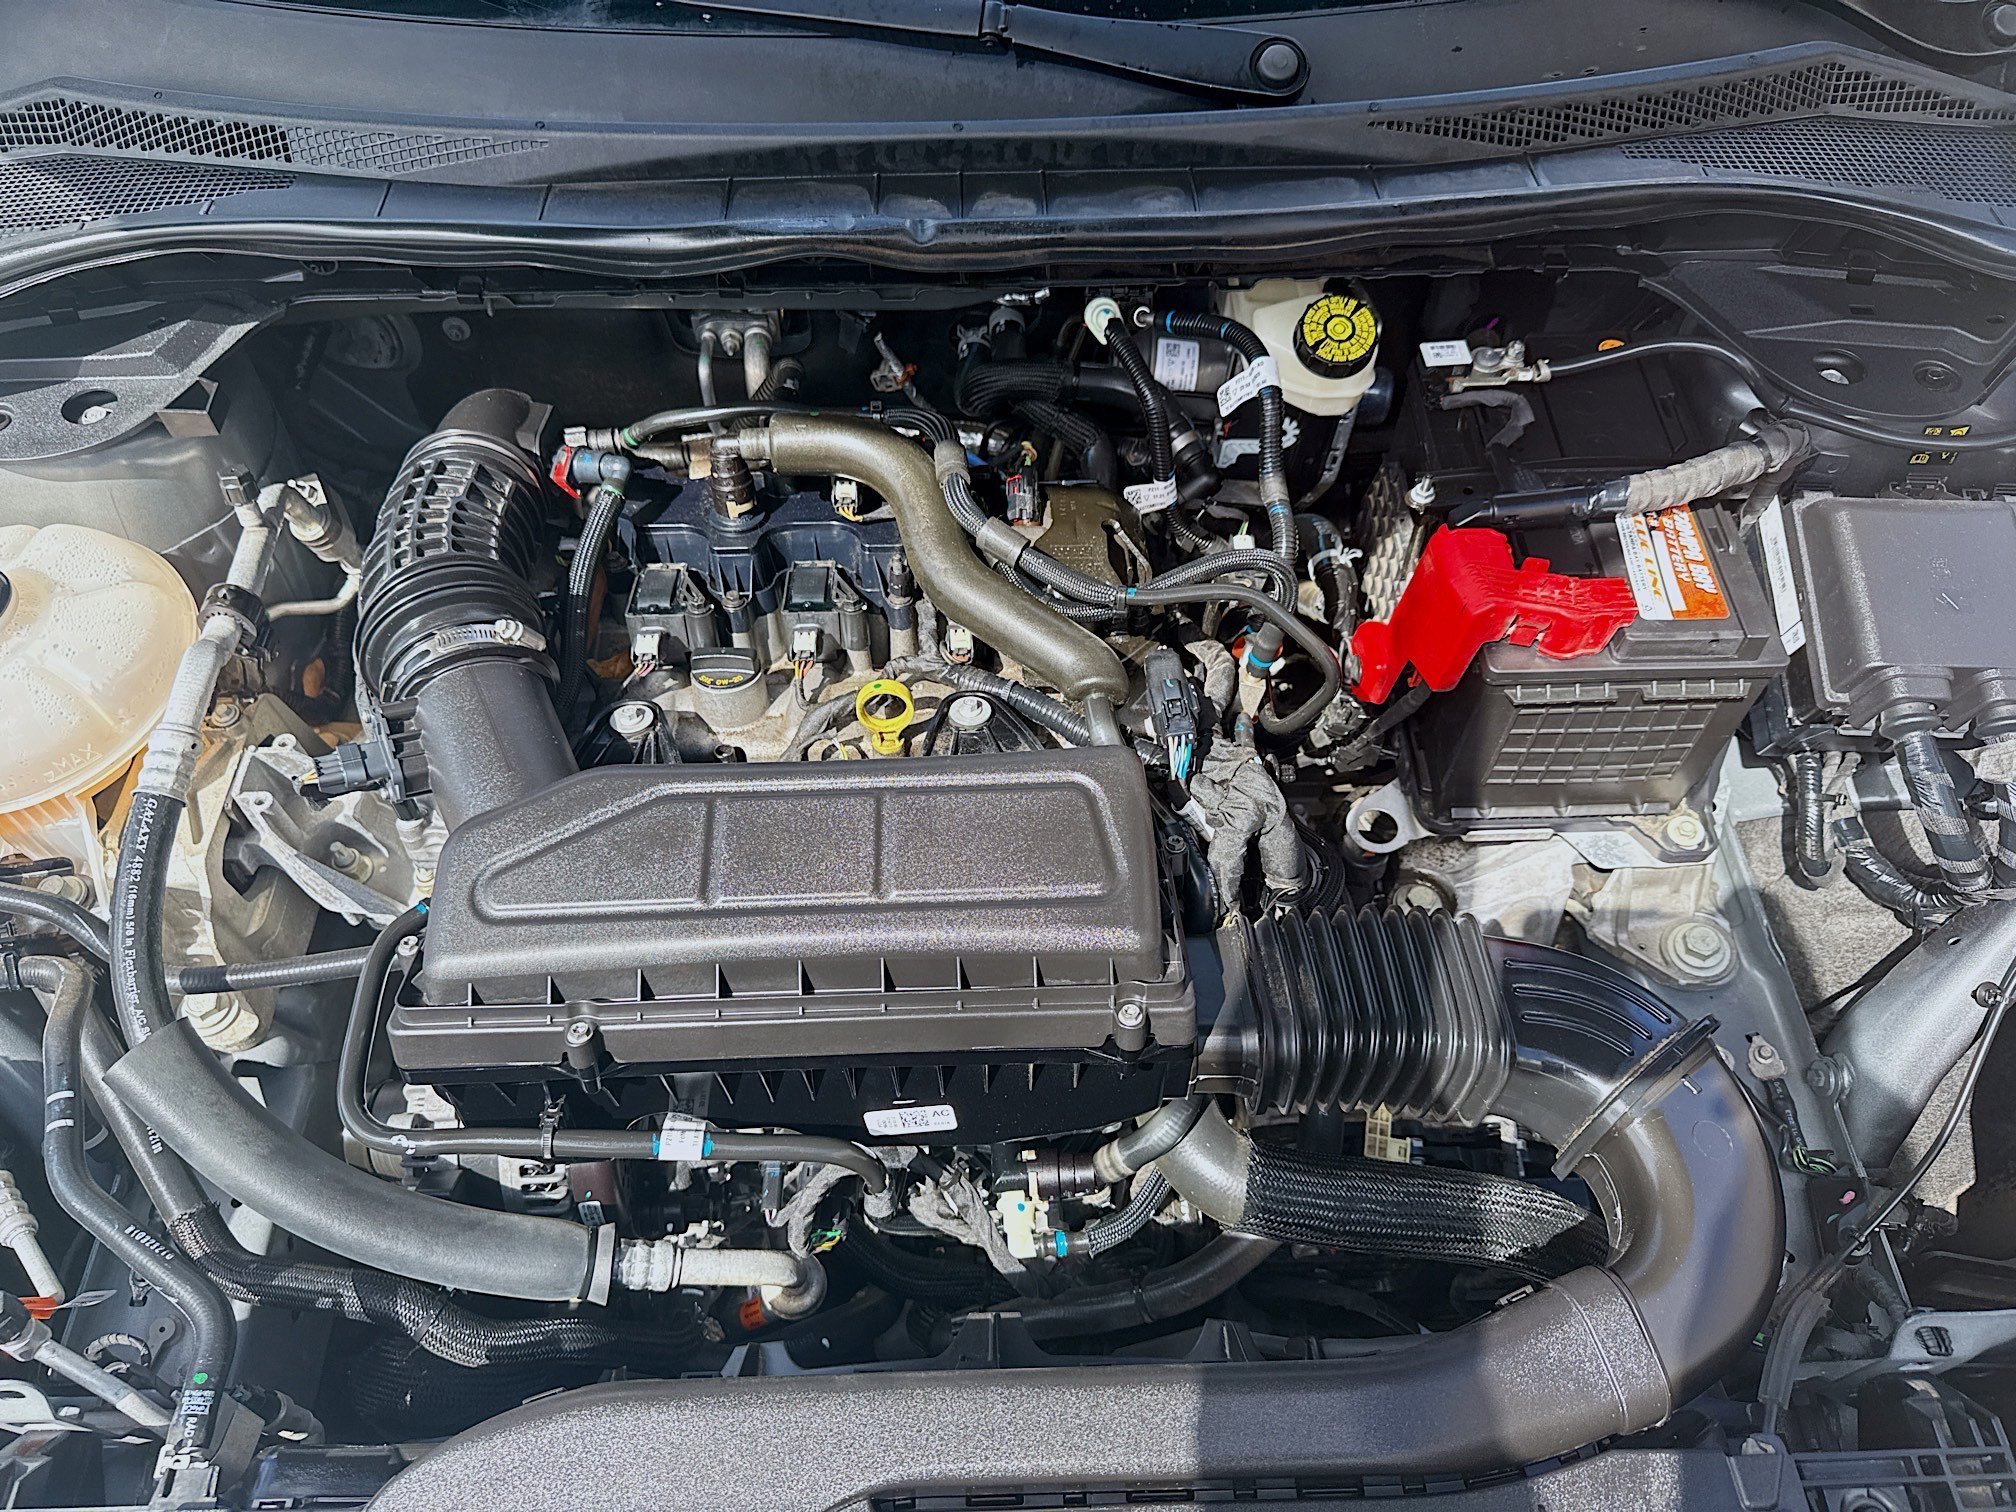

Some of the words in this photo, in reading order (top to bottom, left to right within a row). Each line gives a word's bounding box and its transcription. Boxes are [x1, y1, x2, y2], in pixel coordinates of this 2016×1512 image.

[1661, 517, 1692, 582] BATTERY
[1672, 508, 1705, 562] TAMPA
[1688, 563, 1719, 595] BAY
[698, 675, 714, 685] SAE
[715, 675, 744, 686] 0W-20
[52, 743, 102, 774] MAX
[136, 797, 158, 854] GALAXY
[130, 855, 144, 882] 4882
[126, 885, 139, 919] (16mm)
[126, 921, 136, 936] 5/8
[125, 949, 141, 1005] Flexbarrier
[133, 1009, 148, 1025] A/C
[932, 1109, 950, 1118] AC
